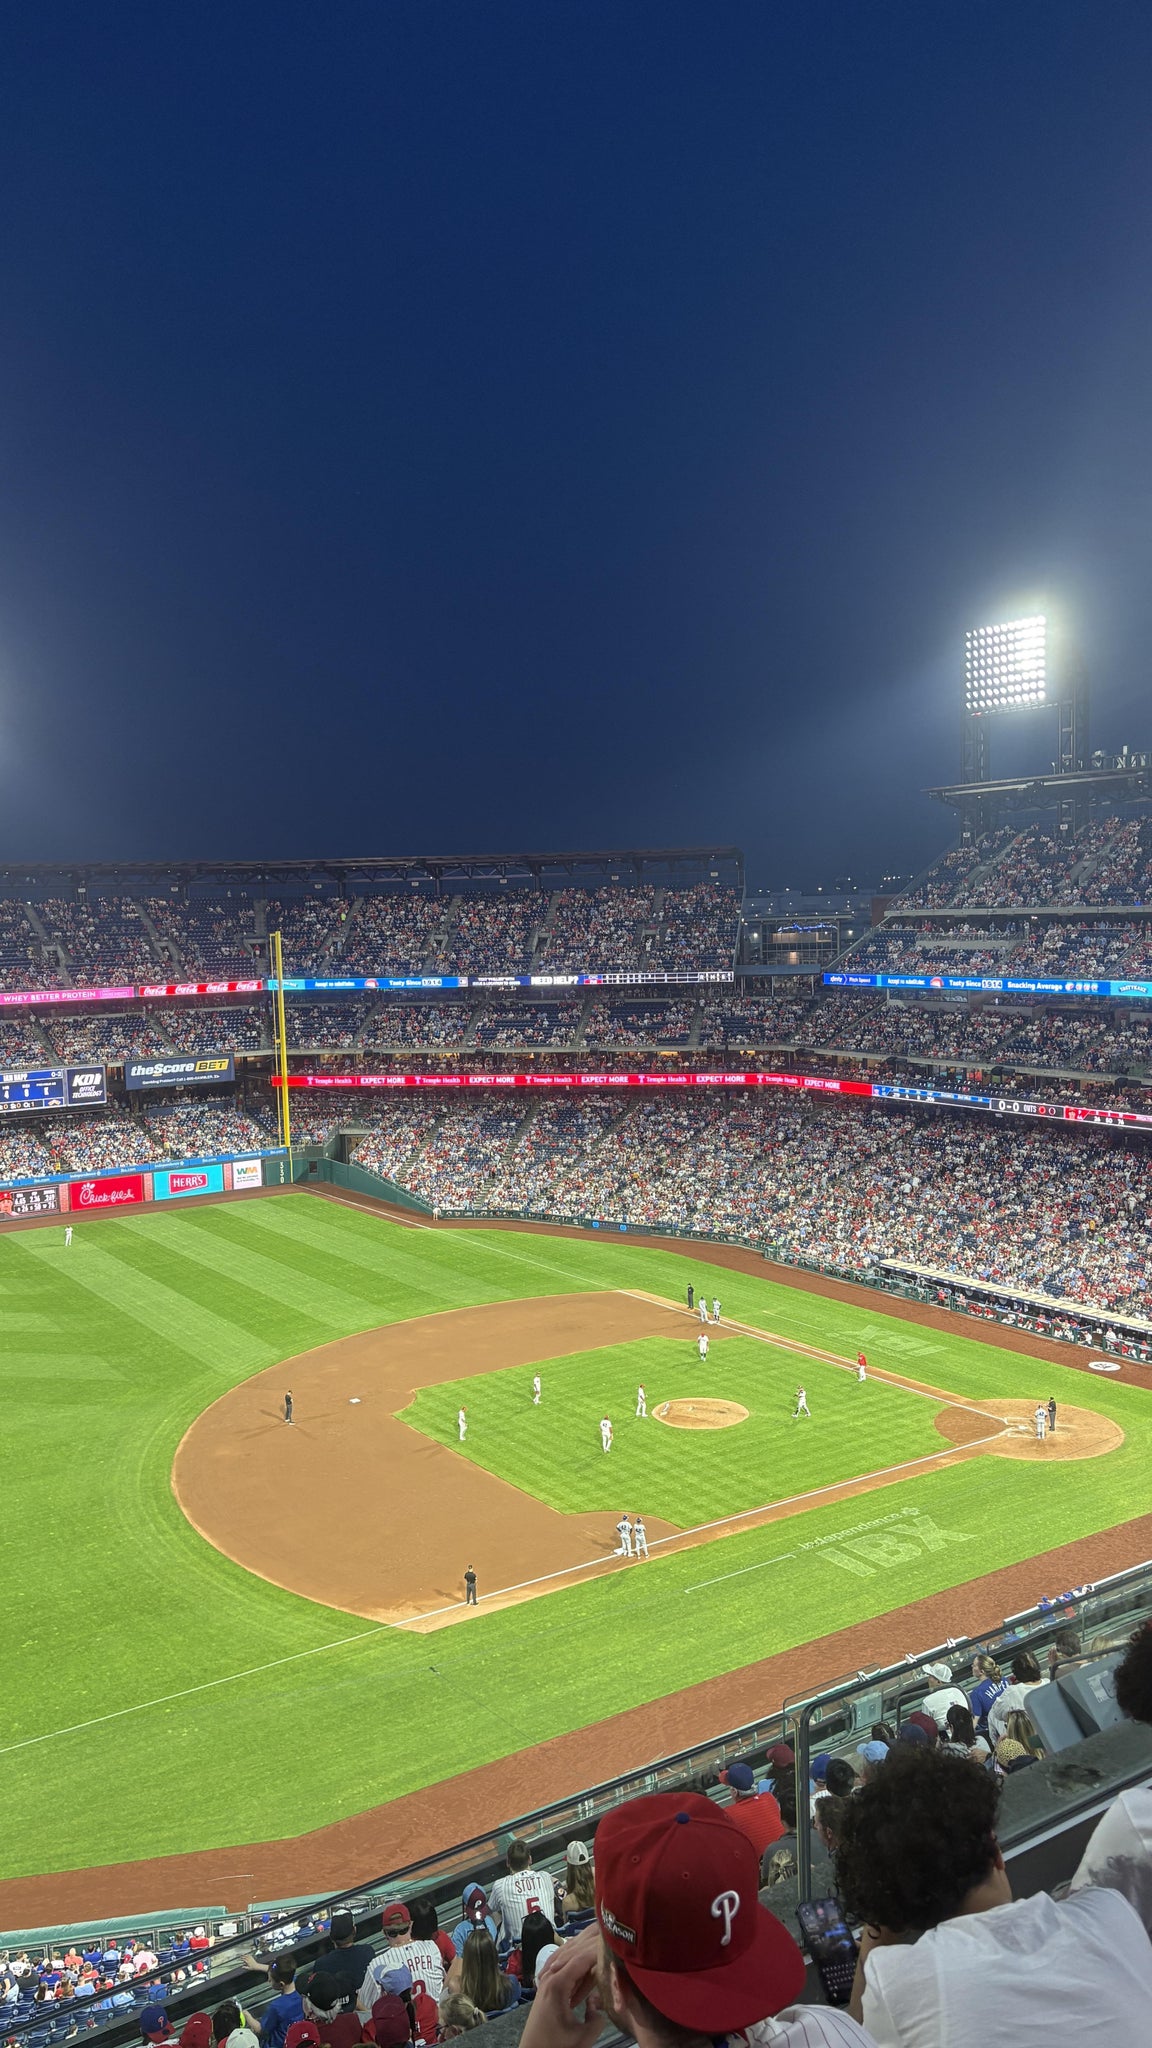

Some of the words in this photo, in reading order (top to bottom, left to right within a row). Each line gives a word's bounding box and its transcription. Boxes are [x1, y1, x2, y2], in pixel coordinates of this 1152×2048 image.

[389, 979, 405, 987] Tasty
[531, 976, 552, 985] NEED
[553, 976, 579, 985] HELP?
[982, 980, 1002, 988] 1914
[1007, 982, 1036, 990] Snacking
[1037, 983, 1062, 991] Average
[4, 995, 27, 1003] WHEY
[31, 993, 59, 1001] BETTER
[62, 991, 96, 999] PROTEIN
[130, 1063, 195, 1077] theScore
[199, 1061, 226, 1070] BET
[804, 1079, 824, 1087] EXPECT
[72, 1090, 103, 1098] TECHNOLOGY
[1023, 1104, 1037, 1113] OUTS
[236, 1167, 258, 1175] WM
[173, 1174, 204, 1188] HERR'S
[798, 1511, 901, 1550] Independence
[815, 1514, 978, 1578] IBX
[515, 1876, 541, 1894] STOTT
[526, 1896, 541, 1915] 5
[711, 1890, 740, 1946] P
[407, 1954, 433, 1973] RPER
